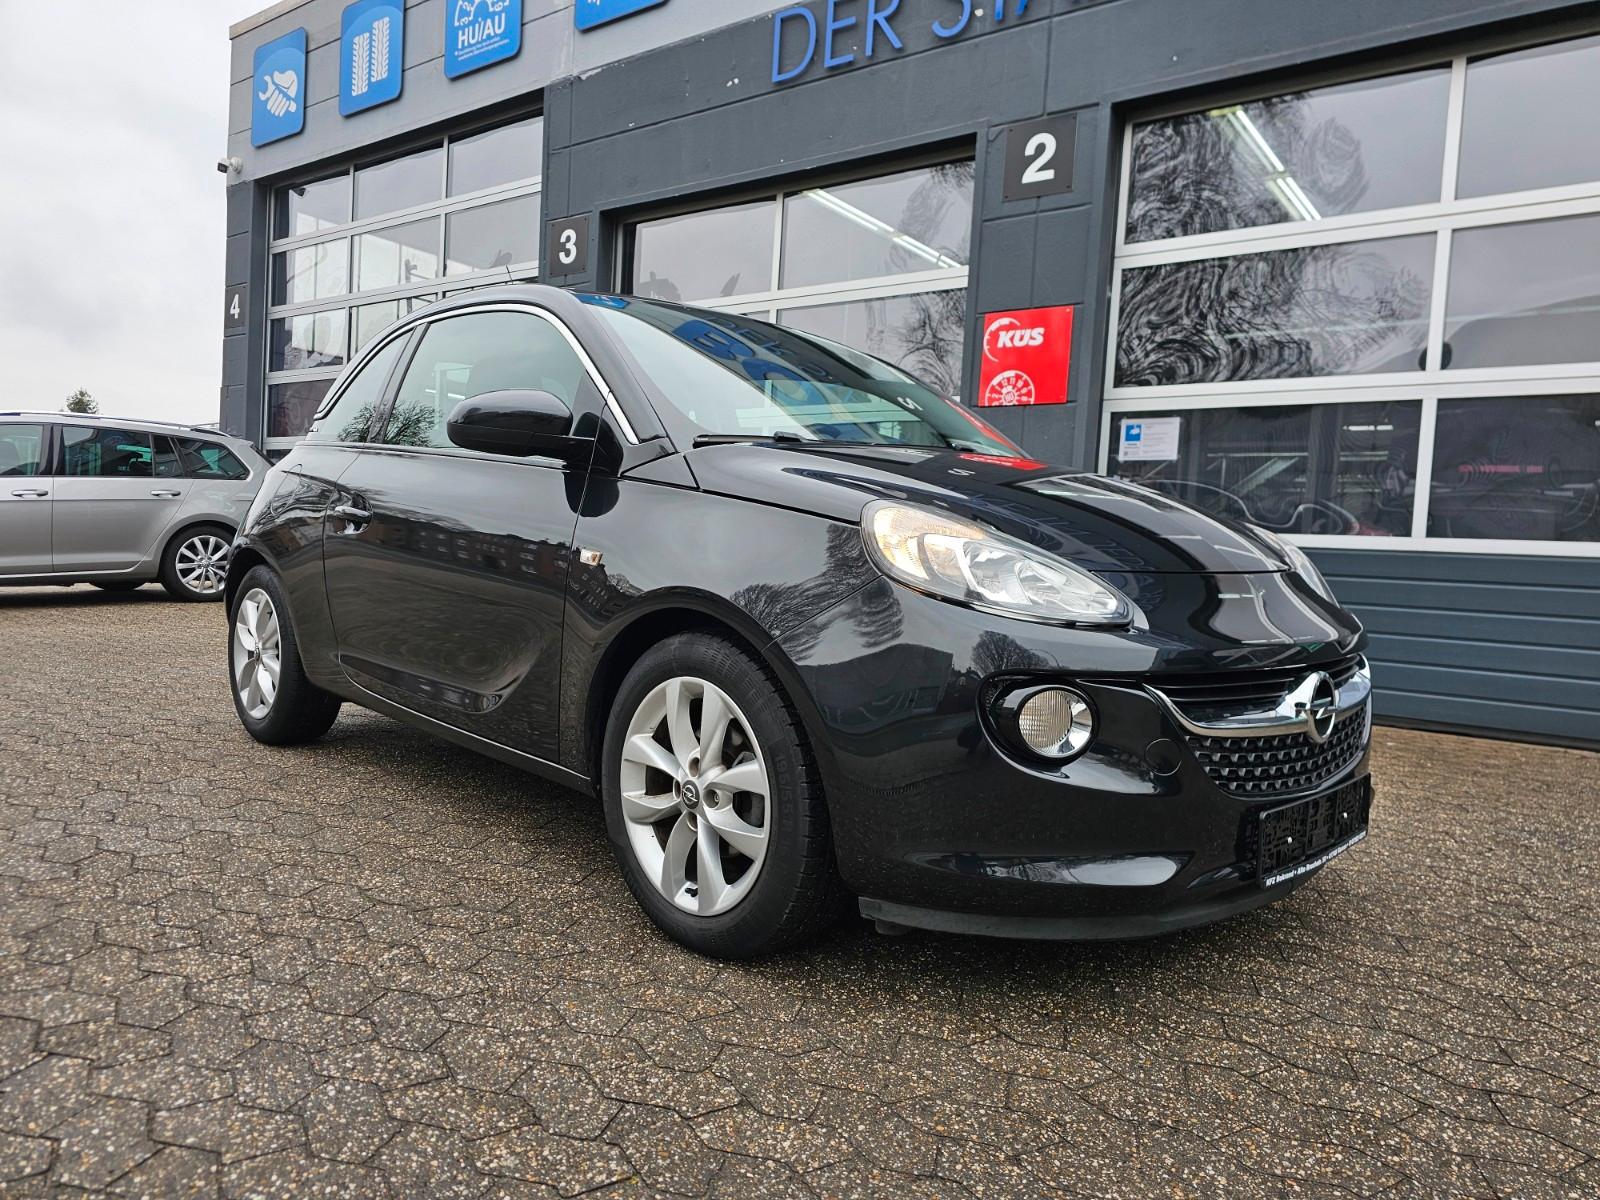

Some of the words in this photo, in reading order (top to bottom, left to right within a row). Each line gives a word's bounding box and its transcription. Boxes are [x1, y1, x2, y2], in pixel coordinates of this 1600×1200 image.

[771, 0, 903, 83] DER
[1021, 132, 1057, 184] 2
[558, 228, 577, 264] 3
[230, 293, 240, 319] 4
